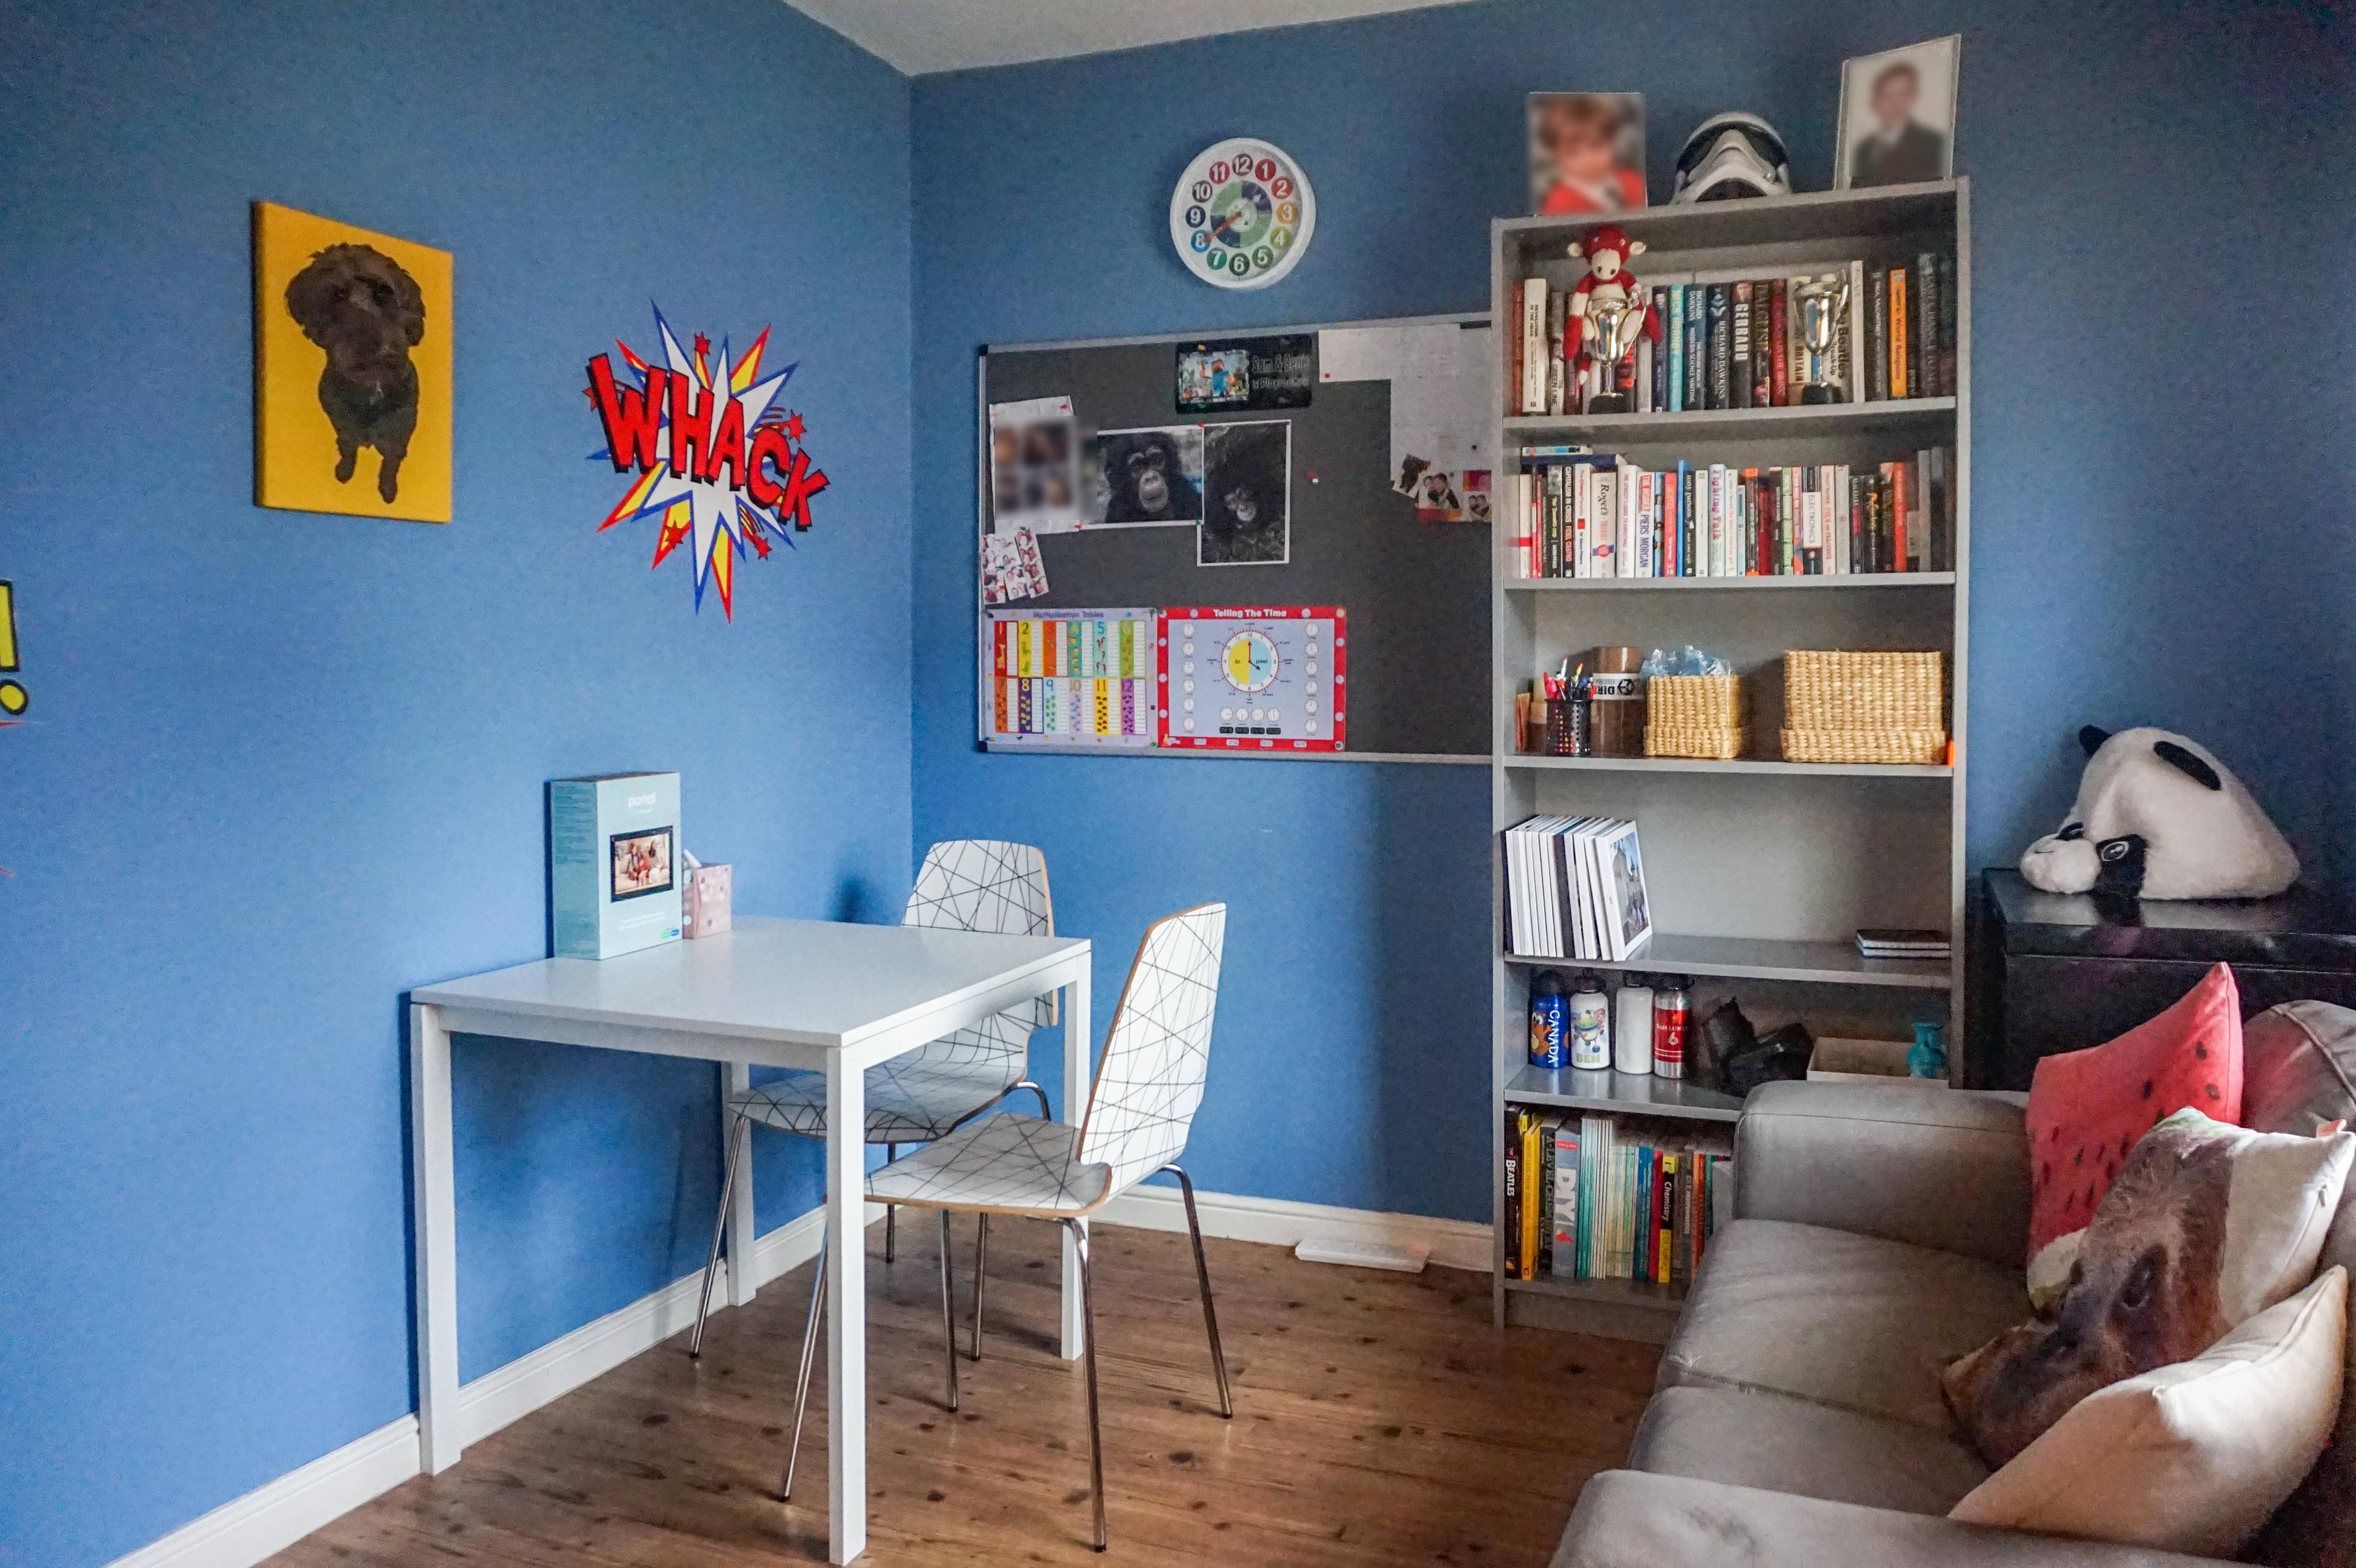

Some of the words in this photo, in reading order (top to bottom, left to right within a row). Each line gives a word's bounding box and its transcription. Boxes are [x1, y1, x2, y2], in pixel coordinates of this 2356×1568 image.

[1212, 164, 1225, 180] 11
[1235, 157, 1250, 172] 12
[1261, 163, 1268, 178] 1
[1194, 183, 1211, 198] 10
[1276, 180, 1287, 195] 2
[1190, 209, 1200, 223] 9
[1282, 205, 1292, 219] 3
[1196, 235, 1205, 248] 8
[1274, 231, 1285, 245] 4
[1212, 250, 1222, 266] 7
[1234, 256, 1244, 272] 6
[1258, 249, 1267, 264] 5
[1734, 304, 1749, 361] GERRARD
[1838, 327, 1850, 379] Beatles
[586, 352, 831, 532] WHACK
[1712, 469, 1722, 513] Fighting
[1598, 484, 1609, 516] Roget's
[1639, 515, 1649, 534] PIERS
[1712, 517, 1722, 540] Talk
[1639, 537, 1649, 567] MORGAN
[1214, 609, 1243, 618] Telling
[1022, 622, 1028, 634] 2
[1098, 621, 1104, 634] 5
[1022, 678, 1030, 691] 8
[1046, 679, 1053, 691] 9
[1069, 679, 1081, 691] 10
[1096, 679, 1107, 692] 11
[1122, 679, 1133, 691] 12
[628, 791, 656, 809] portal
[1548, 1010, 1560, 1064] CANADA
[1668, 1032, 1679, 1045] 6
[1546, 1135, 1555, 1183] A-LEVEL
[1506, 1159, 1516, 1197] BEATLES
[1555, 1167, 1577, 1224] DIY
[1661, 1181, 1672, 1222] Chemistry
